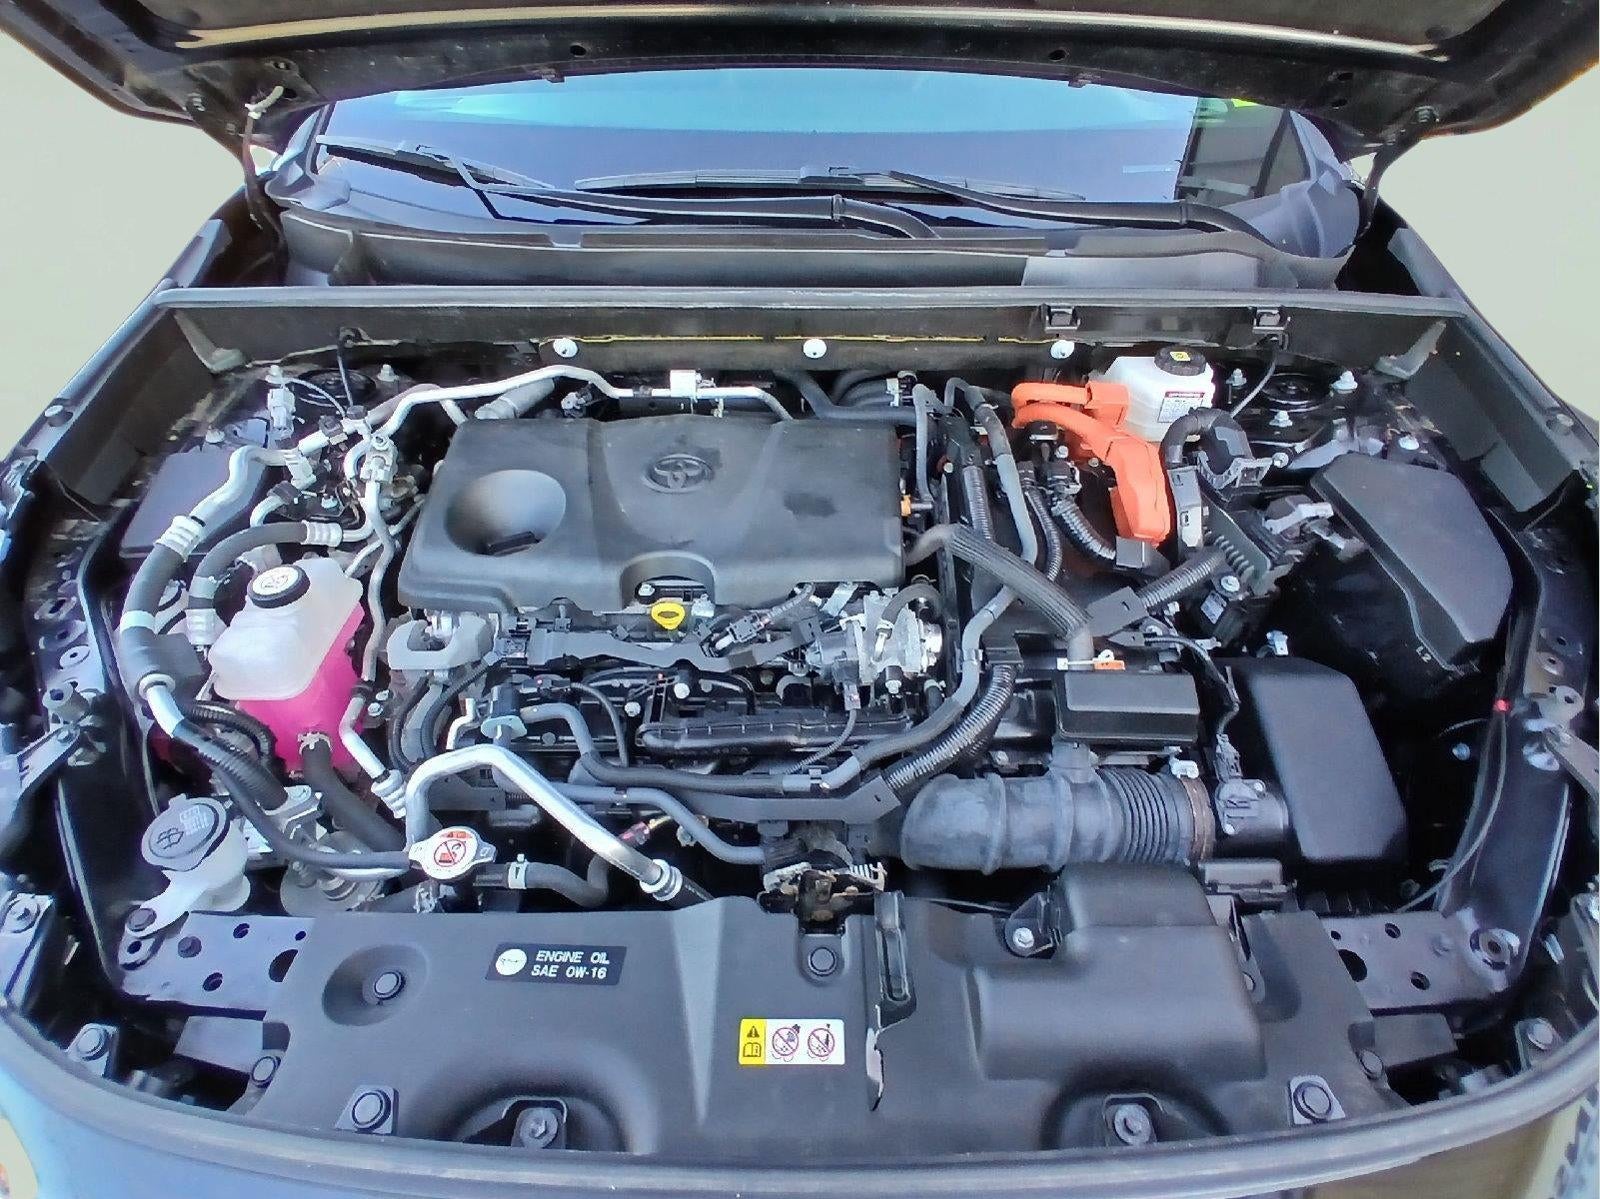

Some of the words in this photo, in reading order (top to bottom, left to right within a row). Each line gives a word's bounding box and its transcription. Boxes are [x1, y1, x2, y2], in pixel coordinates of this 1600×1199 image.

[536, 950, 584, 963] ENGINE
[590, 952, 610, 964] OIL
[531, 965, 559, 977] SAE
[565, 966, 608, 979] 0W-16
